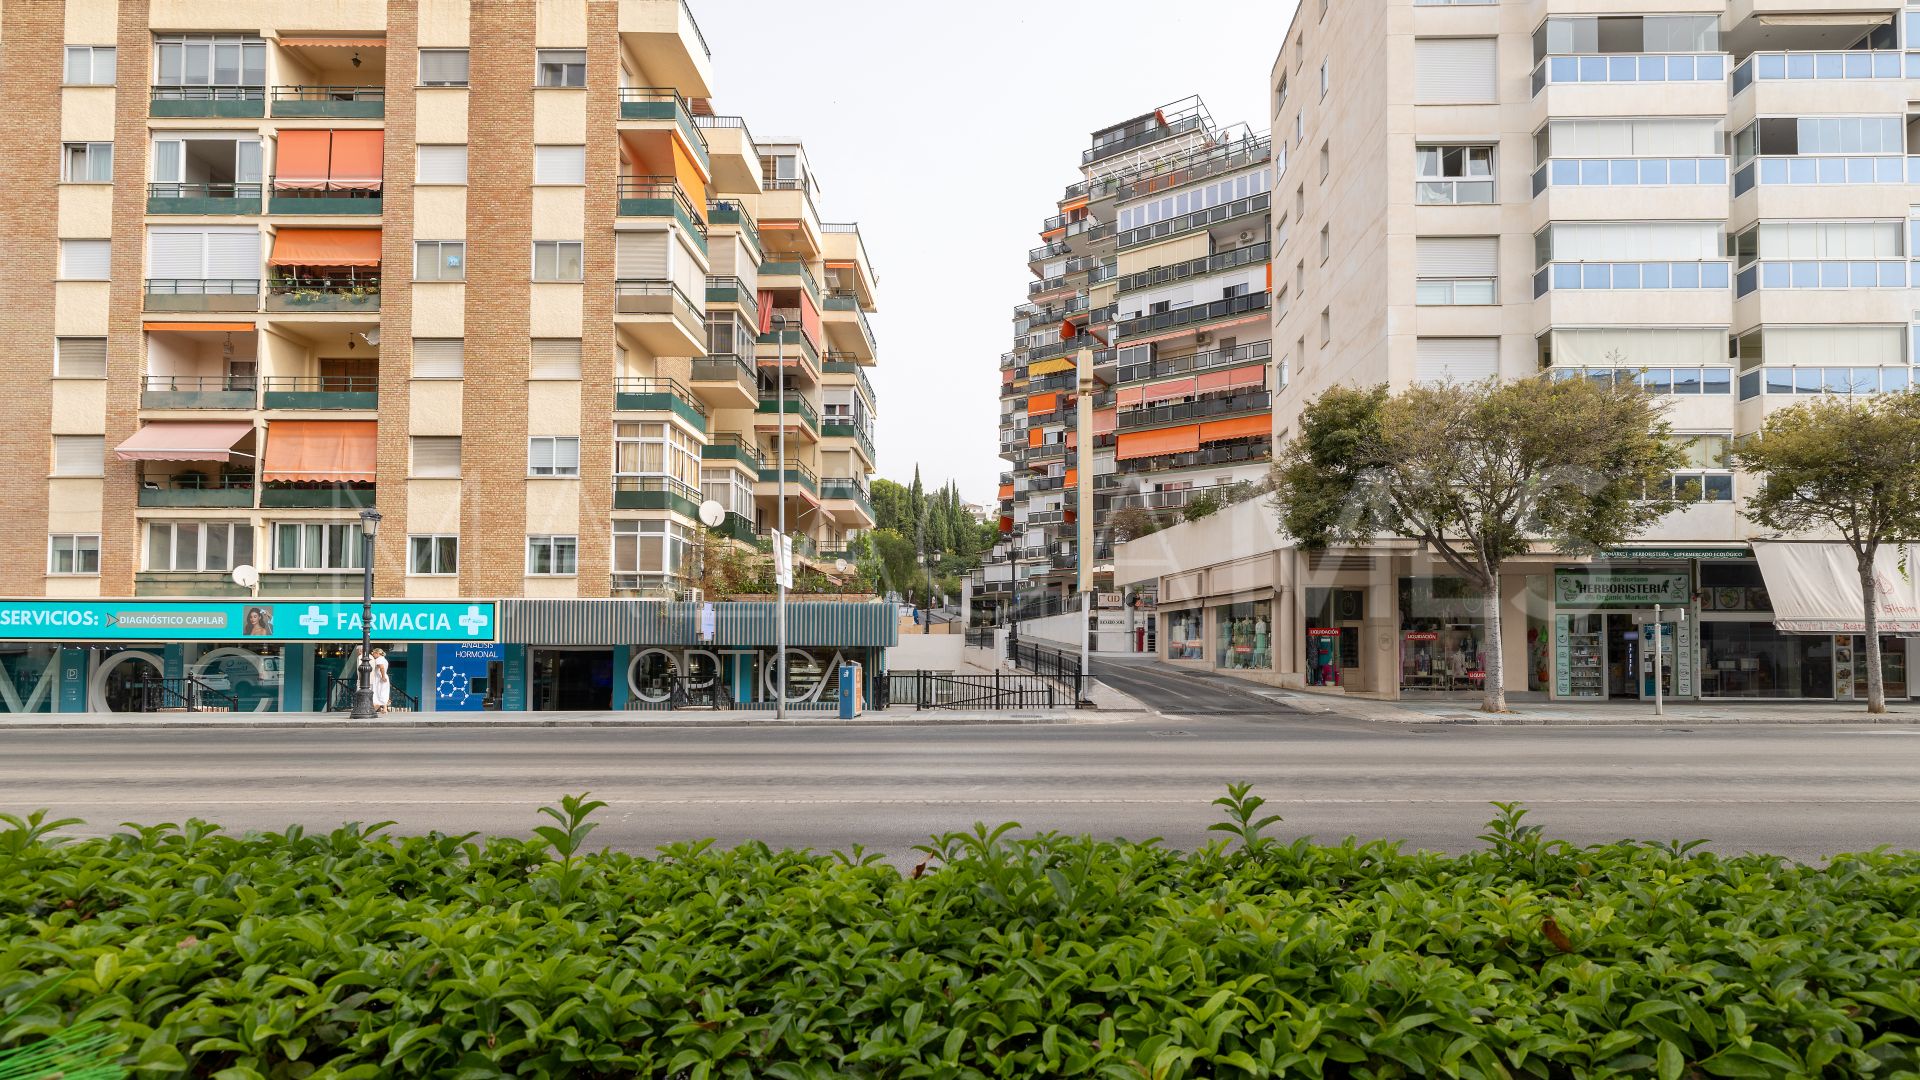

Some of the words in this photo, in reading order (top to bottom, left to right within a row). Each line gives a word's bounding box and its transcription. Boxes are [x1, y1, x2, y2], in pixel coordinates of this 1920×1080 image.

[0, 609, 99, 626] SERVICIOS:
[119, 614, 184, 625] DIAGNÓSTICO
[185, 616, 225, 625] CAPILAR
[455, 650, 498, 658] HORMONAL
